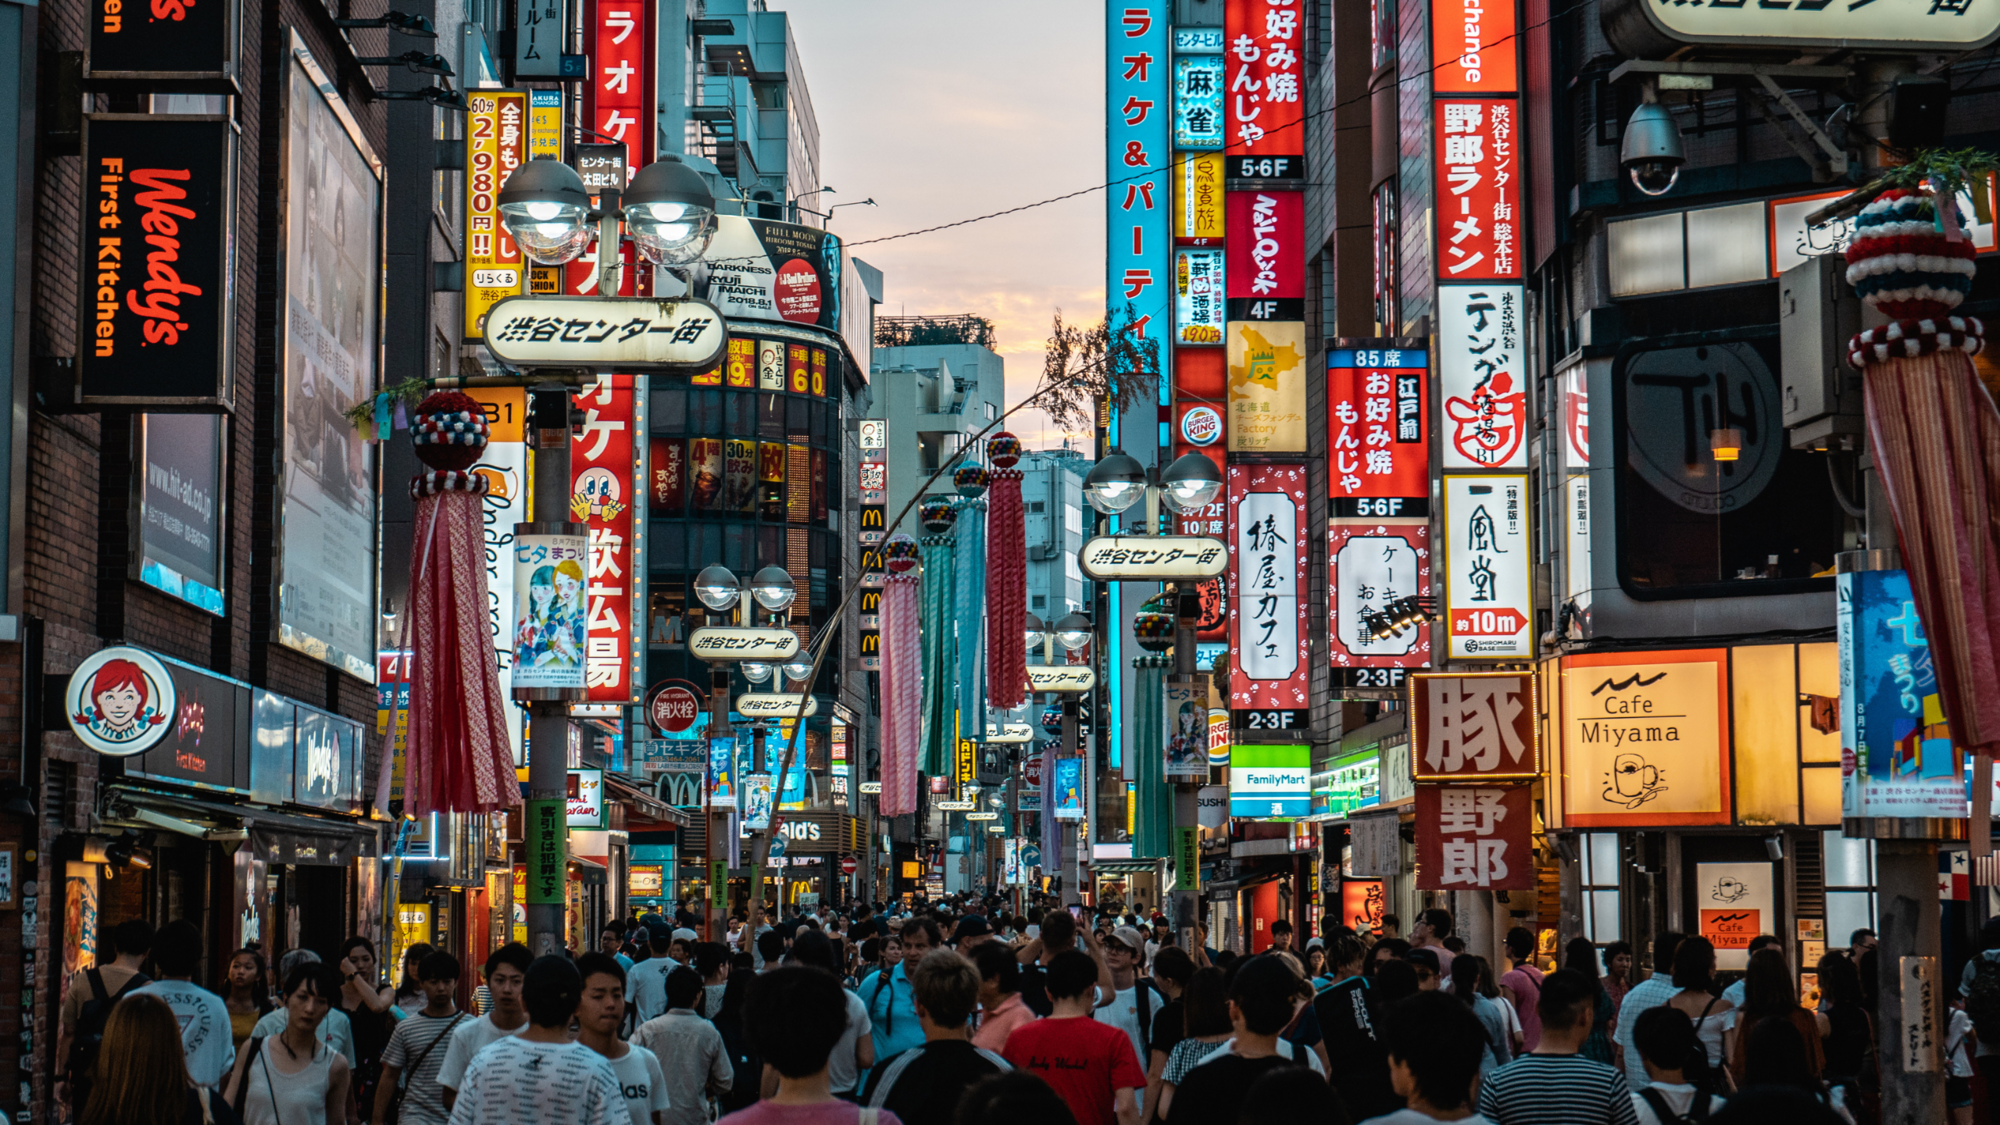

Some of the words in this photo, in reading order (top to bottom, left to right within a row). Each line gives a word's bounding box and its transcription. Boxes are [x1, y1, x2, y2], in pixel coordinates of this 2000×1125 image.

[1174, 33, 1223, 48] センタービル
[1232, 33, 1264, 147] もんじゃ
[471, 98, 495, 113] 60分
[1186, 70, 1213, 134] 麻雀
[580, 157, 622, 168] センター街
[1491, 105, 1512, 222] 渋谷センター街
[583, 173, 619, 186] 太田ビル
[101, 158, 123, 229] First
[1196, 160, 1215, 231] 鳥貴族
[1444, 104, 1485, 275] 野郎ラーメン
[765, 226, 790, 239] FULL
[792, 230, 816, 243] MOON
[765, 236, 795, 246] HIROOMI
[796, 240, 816, 250] TOSAKA
[1193, 238, 1208, 246] 4F
[1493, 222, 1513, 274] 総本店
[708, 263, 772, 275] DARKNESS
[476, 273, 514, 284] りらくる
[95, 237, 122, 357] Kitchen
[480, 290, 510, 301] 渋谷店
[718, 286, 767, 297] IMAICHI
[1190, 253, 1211, 324] 一軒め酒場
[727, 297, 772, 307] 2018.8.1
[1251, 301, 1278, 319] 4F
[1501, 291, 1517, 350] 東京渋谷
[496, 316, 712, 345] 渋谷センター街
[1183, 327, 1222, 342] 190円
[1465, 292, 1510, 392] テング
[775, 344, 784, 388] やきとり
[483, 402, 513, 424] B1
[1235, 402, 1271, 413] 北海道
[1398, 378, 1419, 441] 江戸前
[1188, 415, 1215, 428] BURGER
[1235, 414, 1303, 423] チーズフォンデュ
[1365, 371, 1393, 475] お好み焼
[1473, 393, 1498, 444] 酒場
[1189, 423, 1216, 437] KING
[1236, 424, 1277, 435] Factory
[727, 442, 754, 459] 30分
[1334, 400, 1362, 494] もんじゃ
[1475, 448, 1496, 464] B1
[1182, 520, 1224, 534] 10席
[514, 539, 549, 565] 七夕
[551, 546, 584, 560] まつり
[1467, 485, 1509, 602] 一風堂
[1090, 548, 1222, 566] 渋谷センター街
[1246, 513, 1288, 659] 椿屋カフェ
[694, 635, 794, 650] 渋谷センター街
[657, 701, 695, 719] 消火栓
[1604, 695, 1653, 715] Cafe
[1425, 676, 1526, 773] 豚
[1581, 721, 1680, 748] Miyama
[660, 741, 707, 756] セキネ
[1246, 774, 1306, 787] FamilyMart
[1197, 798, 1227, 808] SUSHI
[1271, 802, 1284, 815] 酒
[1439, 787, 1509, 888] 野郎
[540, 805, 557, 897] 客引きは犯罪です
[1718, 923, 1744, 932] Cafe
